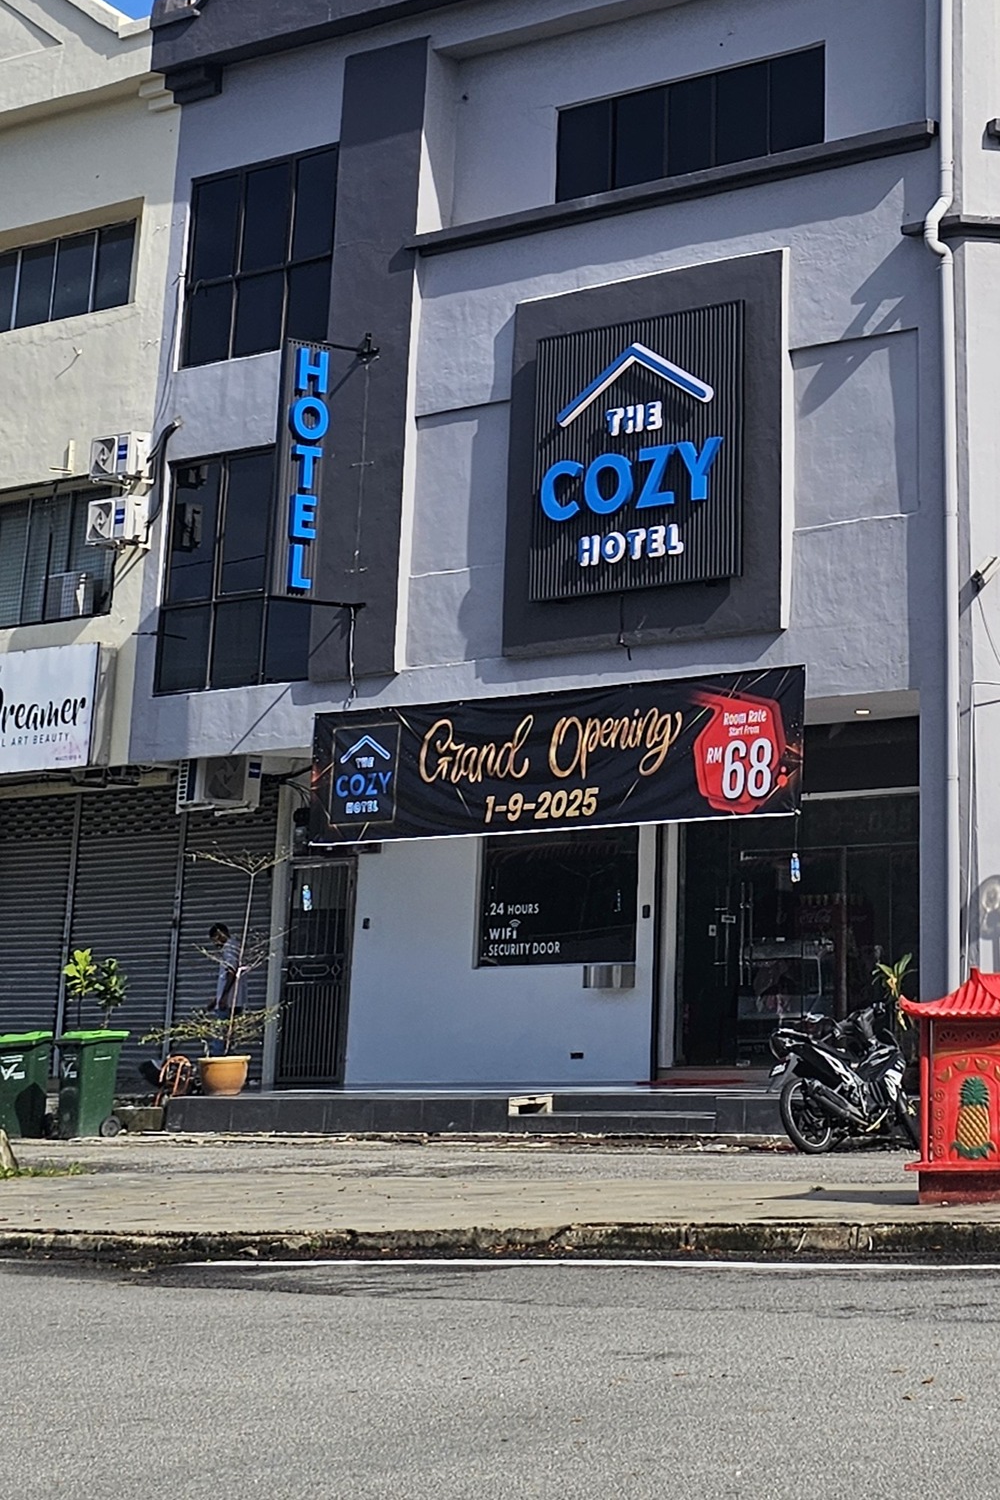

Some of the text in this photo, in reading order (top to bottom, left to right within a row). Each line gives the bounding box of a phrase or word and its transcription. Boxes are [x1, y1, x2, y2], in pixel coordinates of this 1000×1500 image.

[606, 401, 662, 436] THE
[287, 347, 330, 590] HOTEL
[541, 436, 724, 521] COZY
[577, 524, 684, 567] HOTEL
[723, 709, 767, 726] Room Rate
[729, 725, 760, 737] Start From
[11, 735, 28, 746] ART
[33, 732, 70, 745] BEAUTY
[418, 707, 683, 784] Grand Opening
[706, 737, 772, 799] RM 68
[336, 772, 392, 797] COZY
[346, 800, 379, 814] HOTEL
[485, 787, 599, 823] 1-9-2025
[507, 903, 540, 915] HOURS
[532, 941, 560, 955] DOOR
